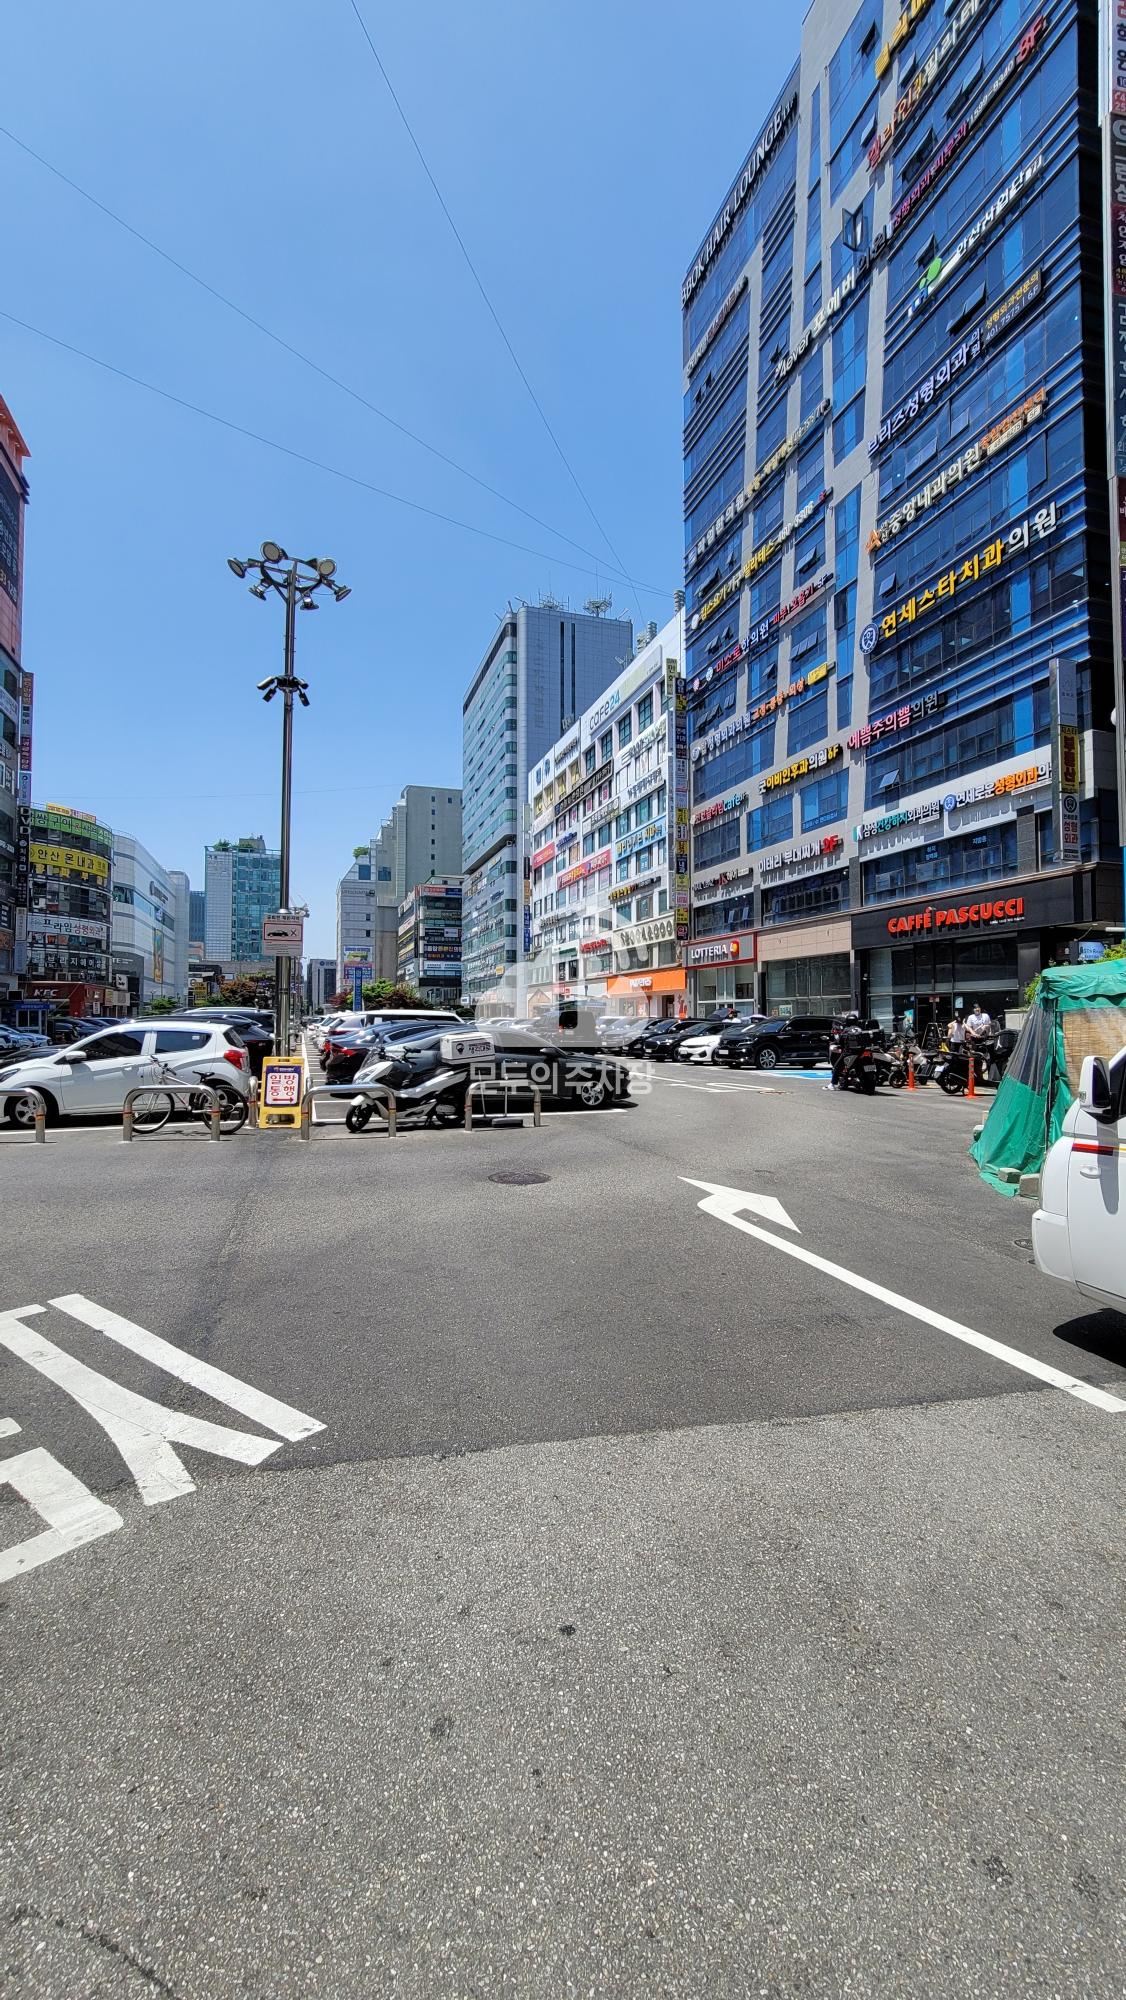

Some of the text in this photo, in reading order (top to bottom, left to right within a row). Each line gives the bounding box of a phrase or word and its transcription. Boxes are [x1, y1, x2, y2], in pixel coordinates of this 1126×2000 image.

[705, 208, 731, 258] HAIR
[733, 105, 783, 213] LOUNGE
[956, 171, 1025, 254] 안산사업단
[811, 266, 856, 338] 포에버
[868, 342, 969, 452] 브리즈성형외과
[889, 441, 983, 534] 중앙내과의원
[848, 691, 939, 749] 예쁨주의쁨의원
[956, 762, 1053, 808] 연세로운성형외과의
[20, 807, 30, 835] DVD
[37, 849, 60, 862] 안산
[757, 852, 782, 872] 이태리
[783, 839, 821, 865] 부대찌개
[42, 918, 72, 933] 프라임
[935, 897, 1025, 926] PASCUCCI
[691, 943, 727, 959] LOTTERIA
[34, 989, 59, 997] KFC
[269, 1085, 295, 1097] 통행
[270, 1074, 296, 1086] 일방
